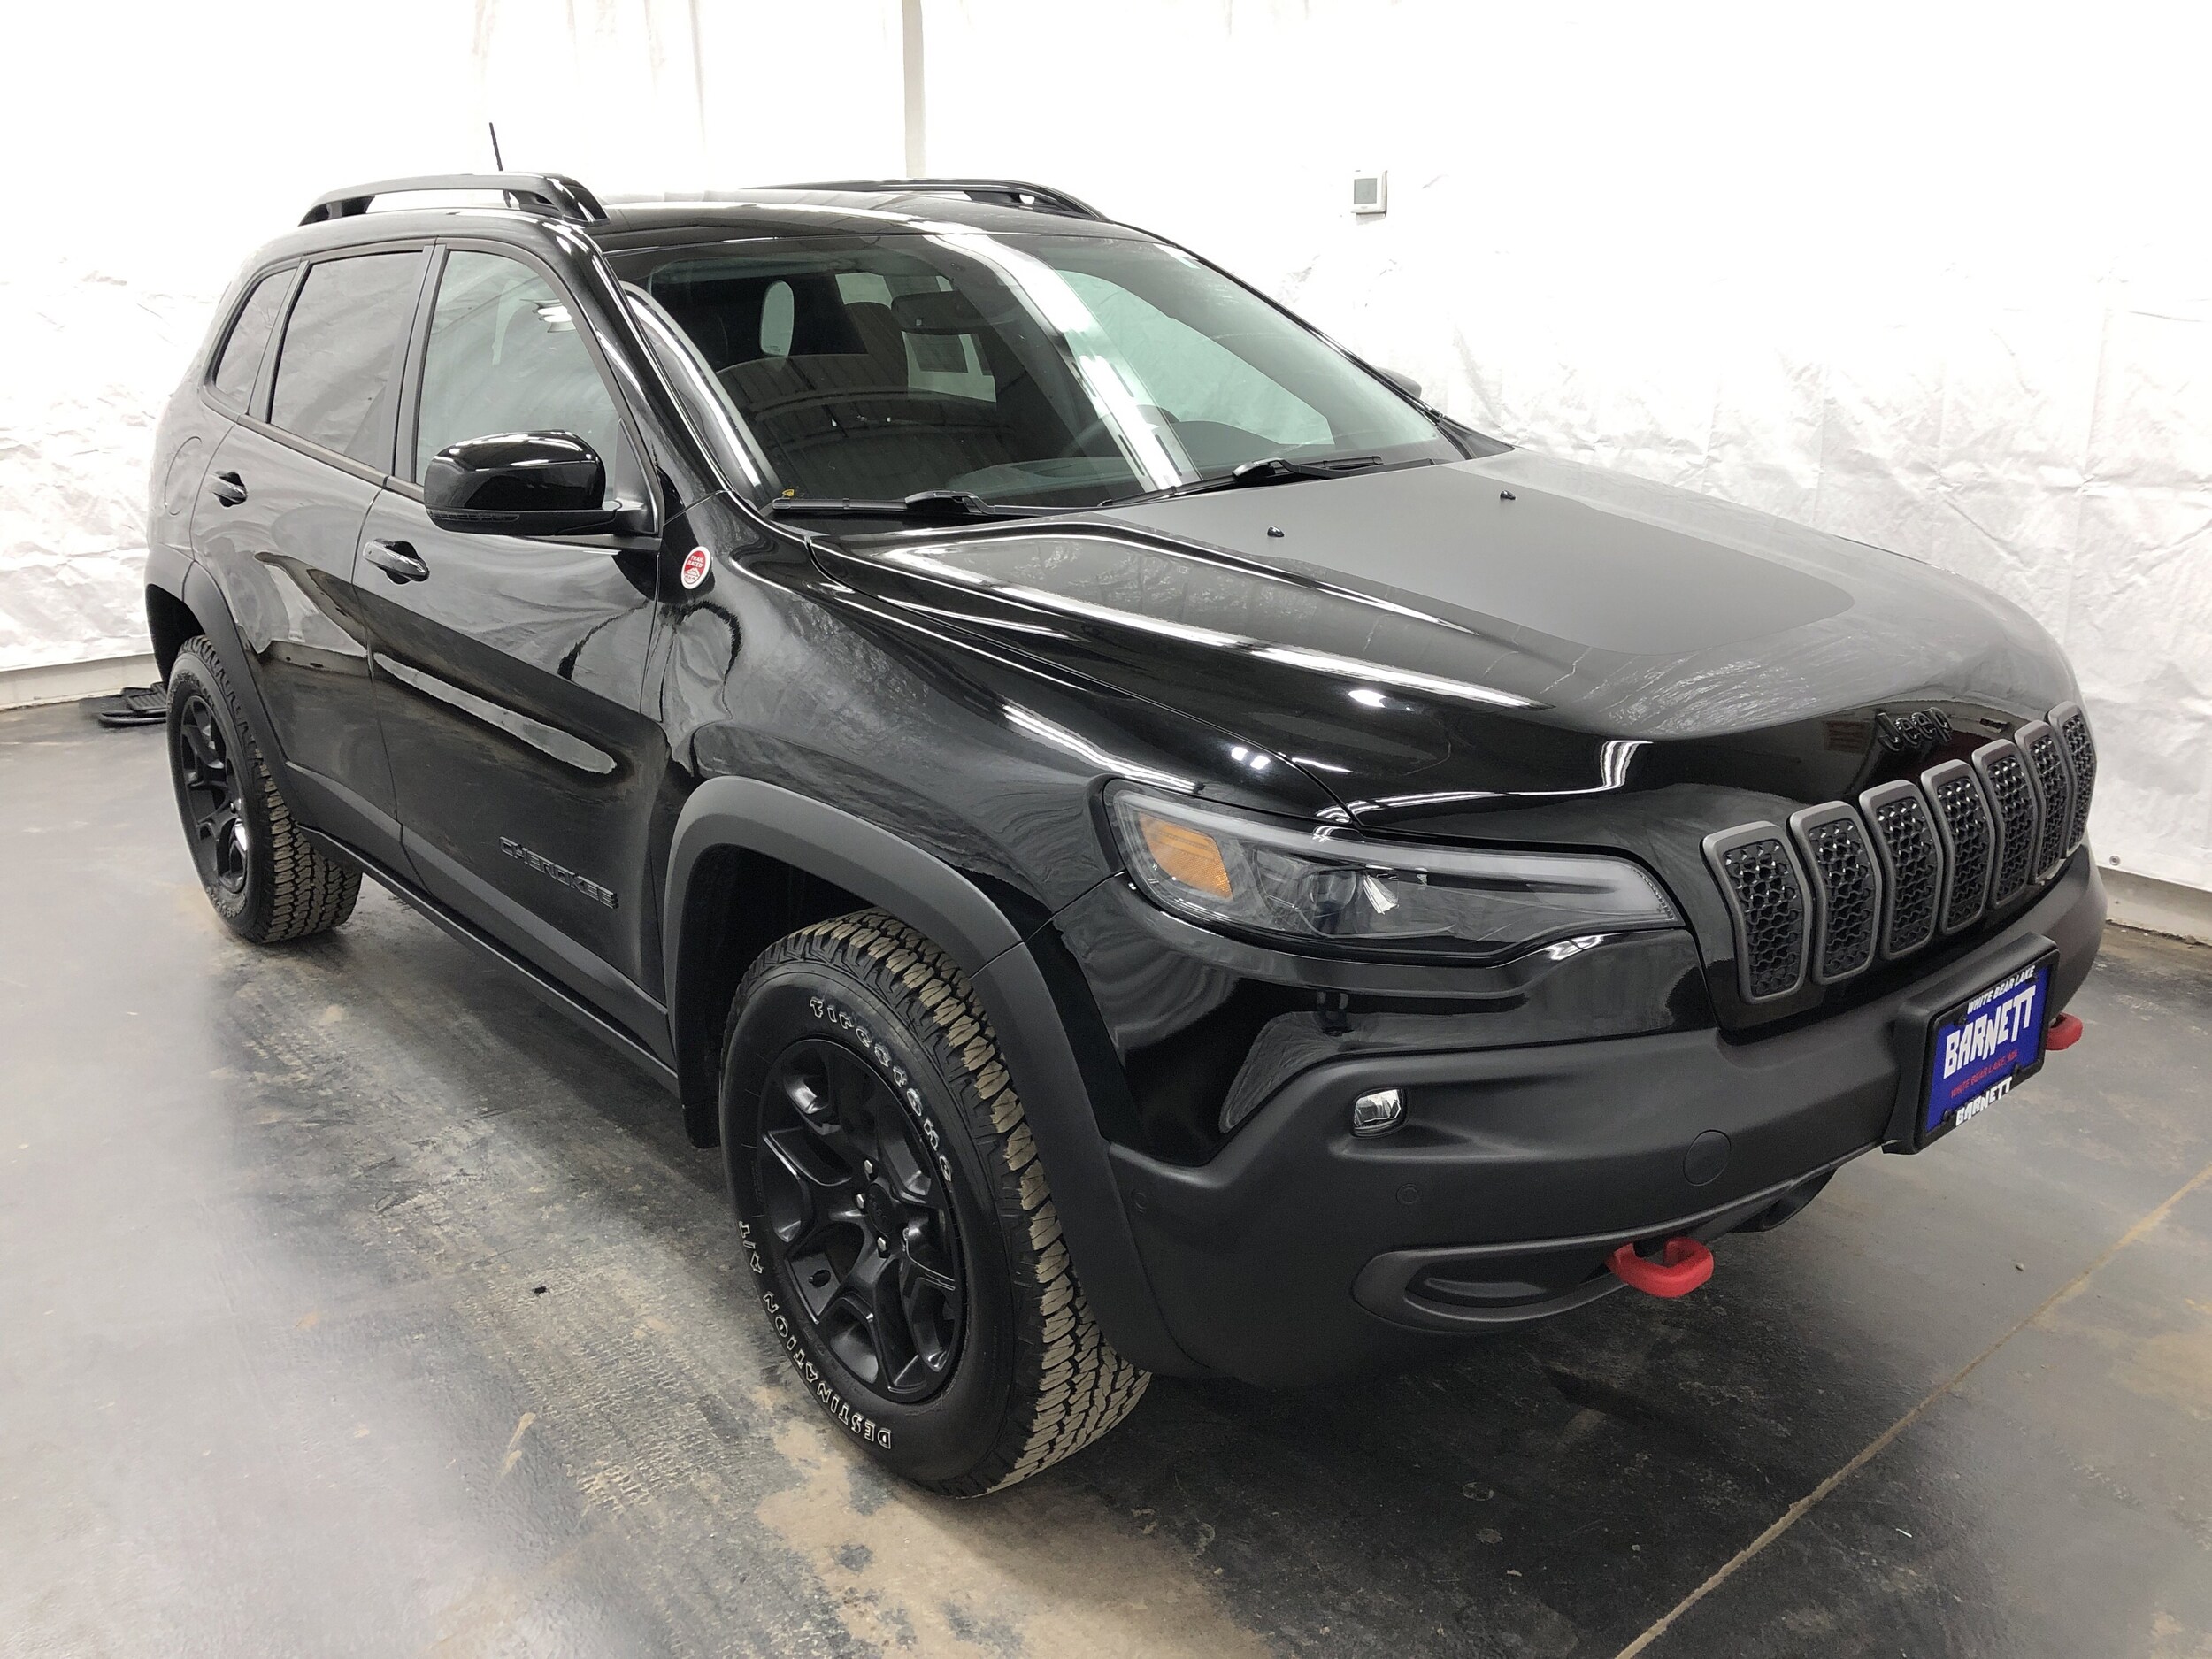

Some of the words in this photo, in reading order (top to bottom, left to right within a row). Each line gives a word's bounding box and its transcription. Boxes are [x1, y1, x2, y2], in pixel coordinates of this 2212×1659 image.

[1876, 707, 1953, 751] Jeep
[499, 836, 618, 909] CHEROKEE
[1967, 989, 1993, 1015] WHITE
[1993, 977, 2015, 999] BEAR
[2014, 965, 2035, 987] LAKE
[1943, 985, 2036, 1079] BARNETT
[1950, 1079, 1970, 1099] WHITE
[1955, 1076, 2013, 1126] BARNETT
[738, 1220, 763, 1274] A/T
[763, 1291, 892, 1449] DESTINATION
